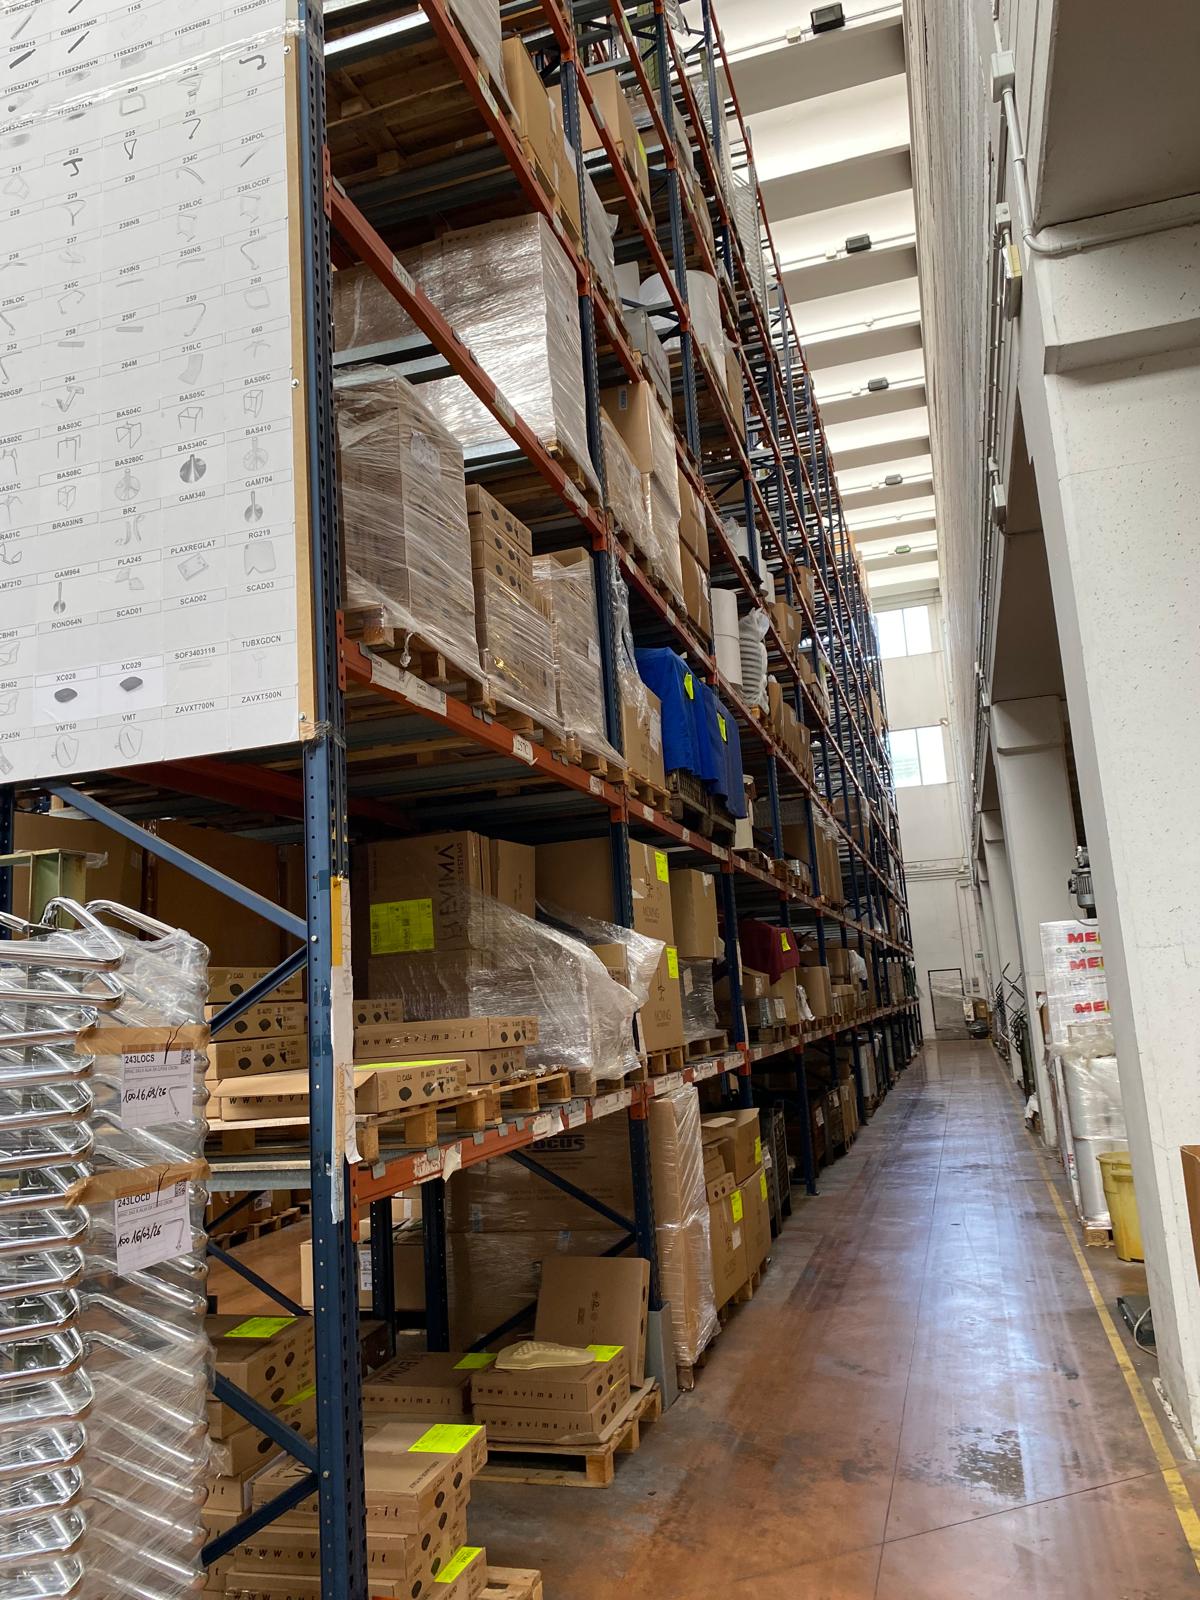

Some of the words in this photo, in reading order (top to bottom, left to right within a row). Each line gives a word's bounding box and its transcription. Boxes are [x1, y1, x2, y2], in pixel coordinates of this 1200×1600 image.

[247, 88, 258, 97] 227
[125, 130, 136, 138] 225
[240, 132, 264, 145] 234POL
[68, 148, 79, 156] 222
[182, 154, 198, 164] 234C
[249, 228, 260, 237] 251
[66, 236, 77, 244] 237
[180, 246, 201, 257] 250INS
[186, 294, 197, 303] 259
[182, 342, 201, 353] 310LC
[179, 390, 205, 402] BAS05C
[116, 406, 142, 418] BAS04C
[245, 424, 272, 436] BAS410
[178, 440, 208, 452] BAS340C
[245, 476, 273, 488] GAM704
[178, 491, 206, 502] GAM340
[122, 506, 136, 515] BRZ
[248, 529, 271, 539] RG219
[170, 540, 216, 555] PLAXREGLAT
[118, 556, 142, 566] PLA245
[246, 582, 275, 592] SCAD03
[180, 594, 207, 605] SCAD02
[116, 608, 142, 618] SCAD01
[242, 635, 282, 648] TUBXGDCN
[121, 662, 142, 671] XC029
[242, 690, 282, 704] ZAVXT500N
[175, 702, 215, 714] ZAVXT700N
[122, 714, 137, 722] VMT
[56, 723, 77, 732] VMT60
[125, 1054, 155, 1064] 243LOCS
[118, 1193, 151, 1208] 243LOCD
